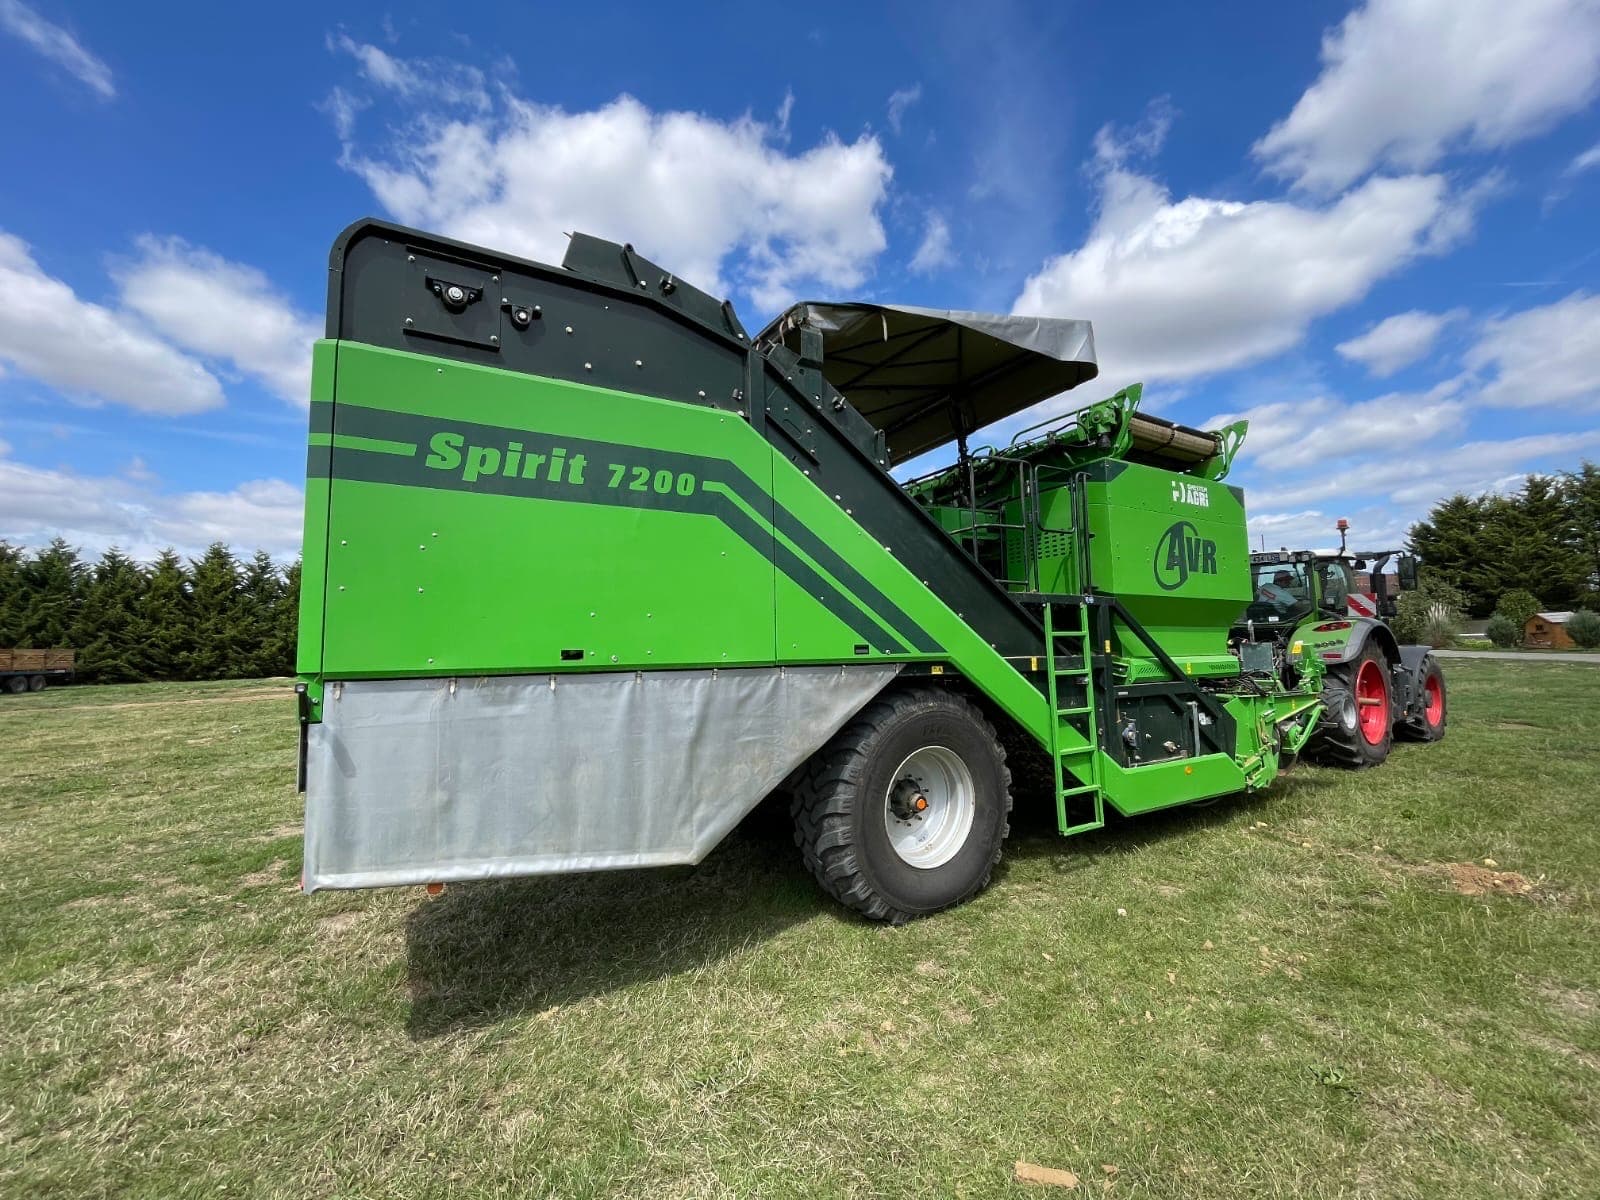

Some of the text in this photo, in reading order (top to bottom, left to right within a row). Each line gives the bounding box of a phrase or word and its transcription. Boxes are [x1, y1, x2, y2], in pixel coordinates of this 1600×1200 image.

[425, 431, 696, 496] Spirit 7200
[1157, 521, 1216, 586] AVR
